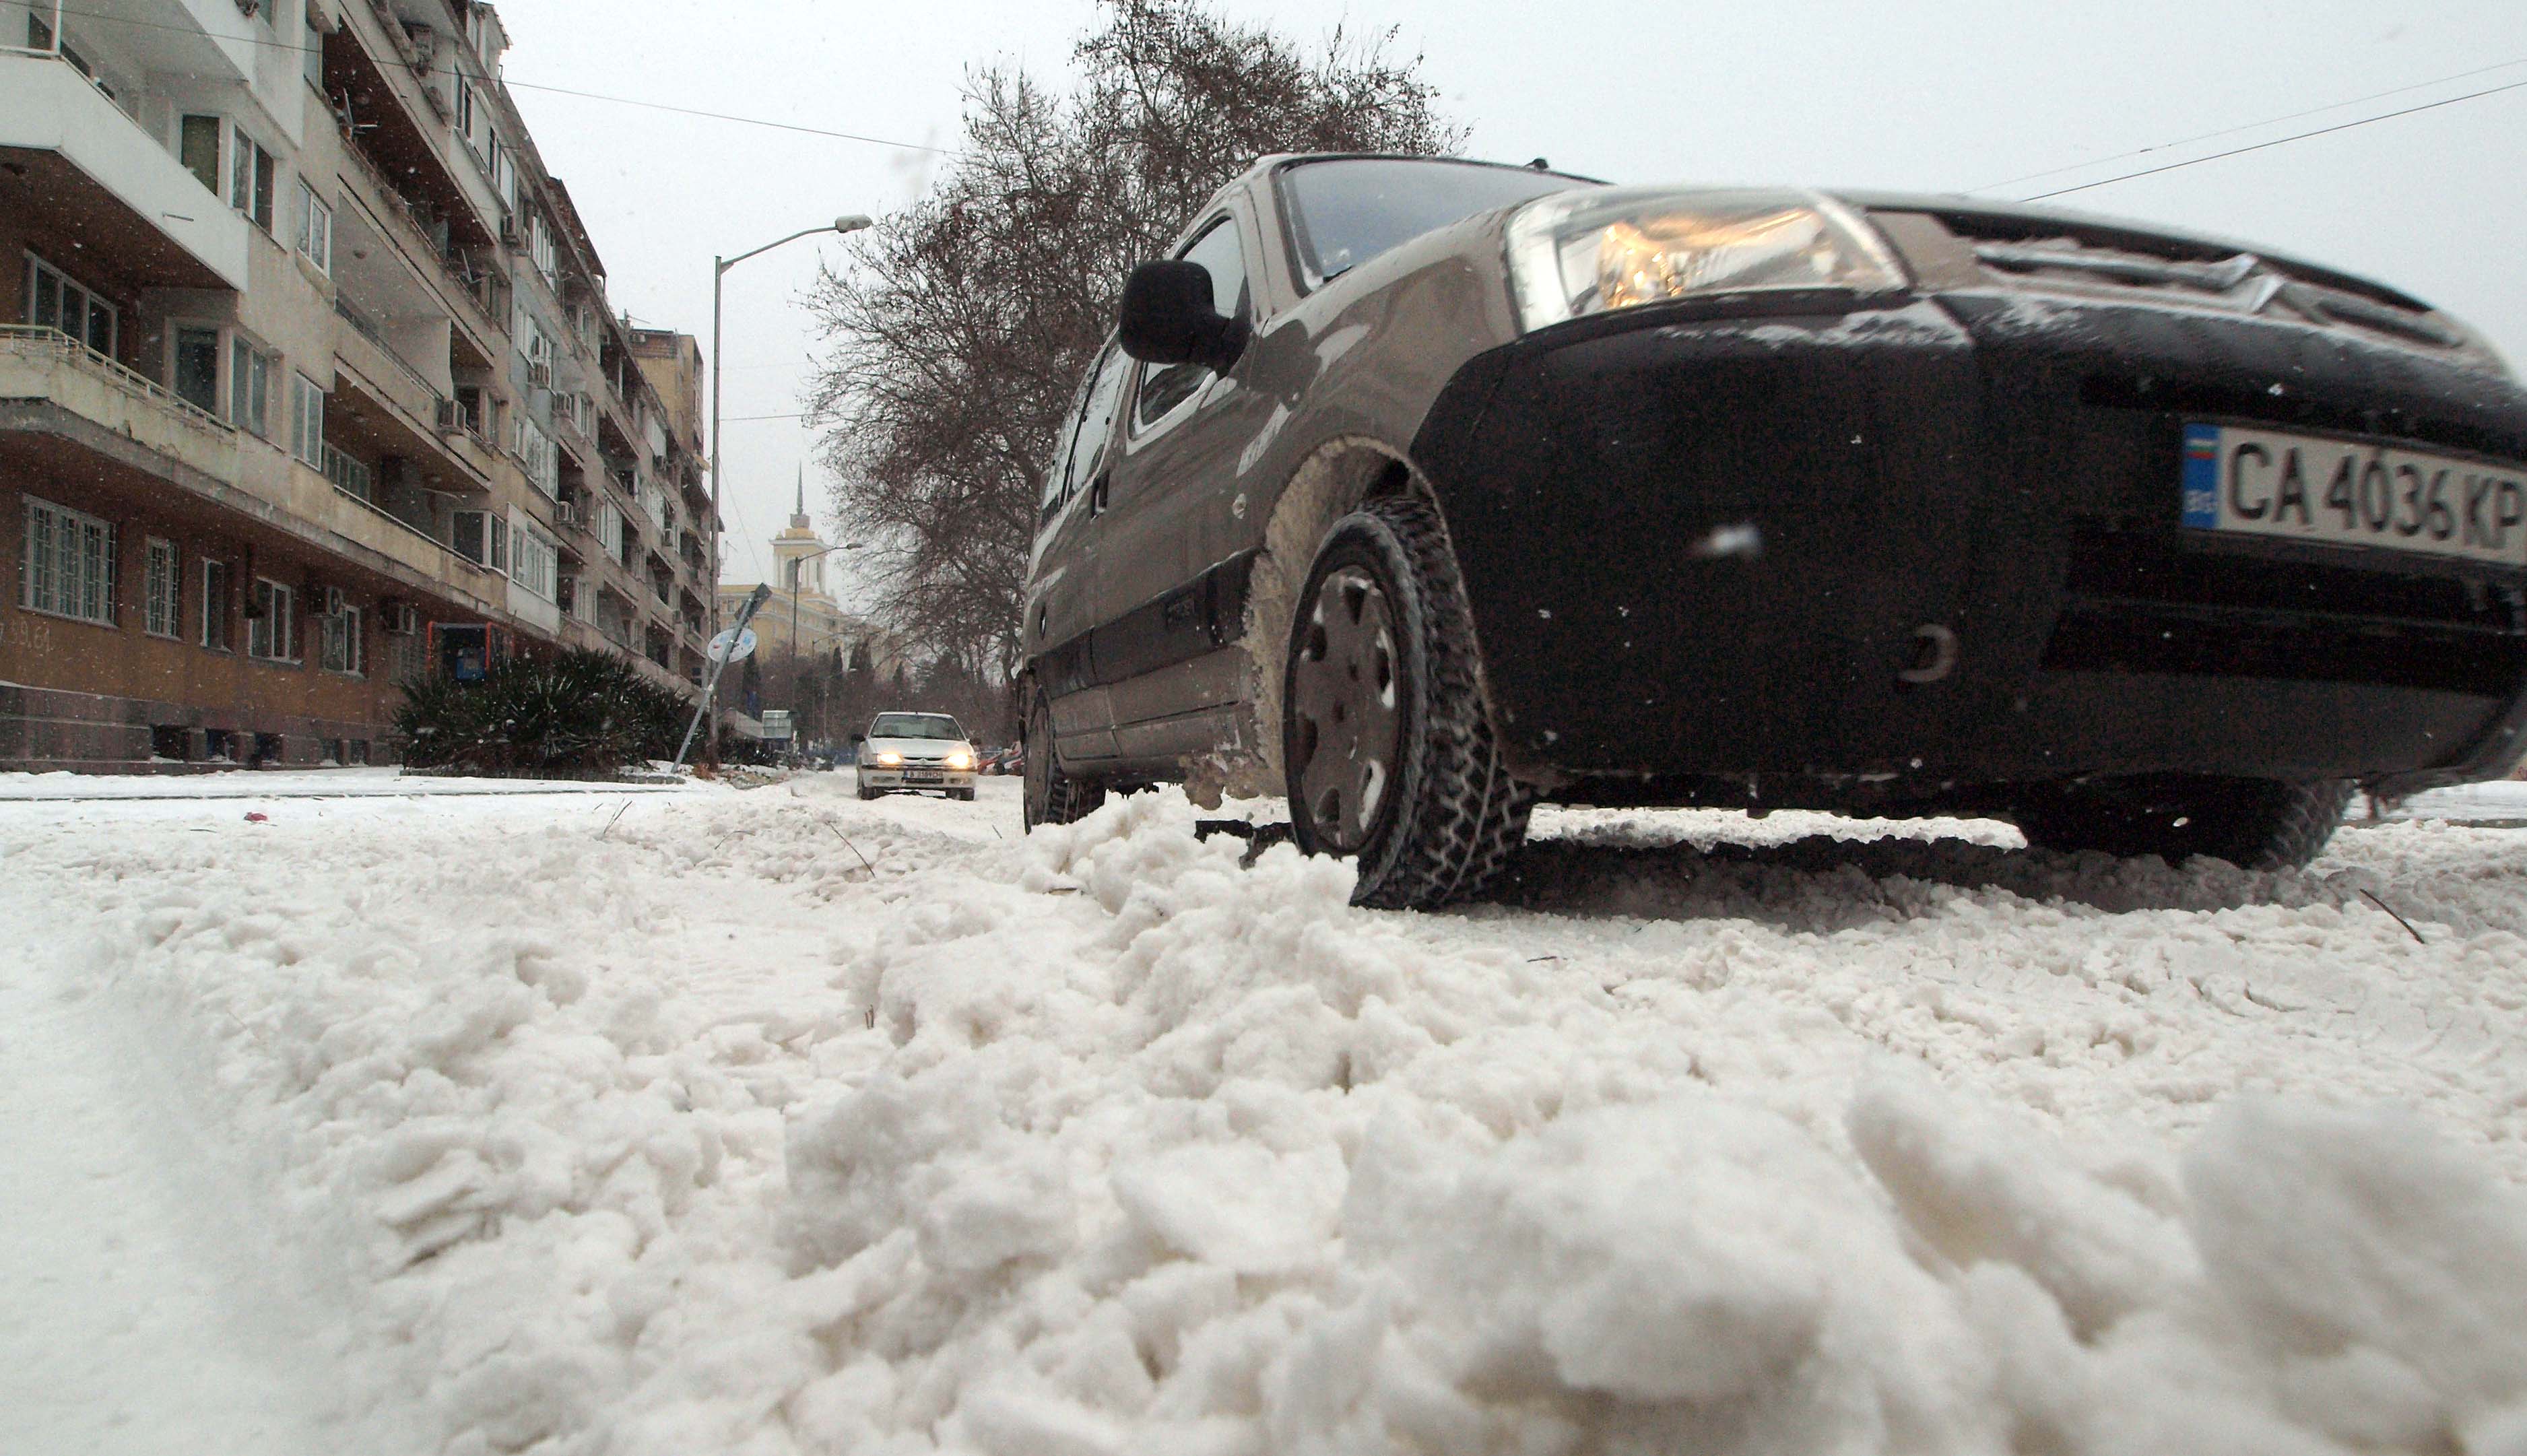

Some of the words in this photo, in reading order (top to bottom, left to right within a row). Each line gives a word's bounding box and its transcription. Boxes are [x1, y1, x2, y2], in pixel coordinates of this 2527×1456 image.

[2227, 442, 2313, 525] CA
[2324, 454, 2455, 539] 4036
[2462, 474, 2524, 550] KP
